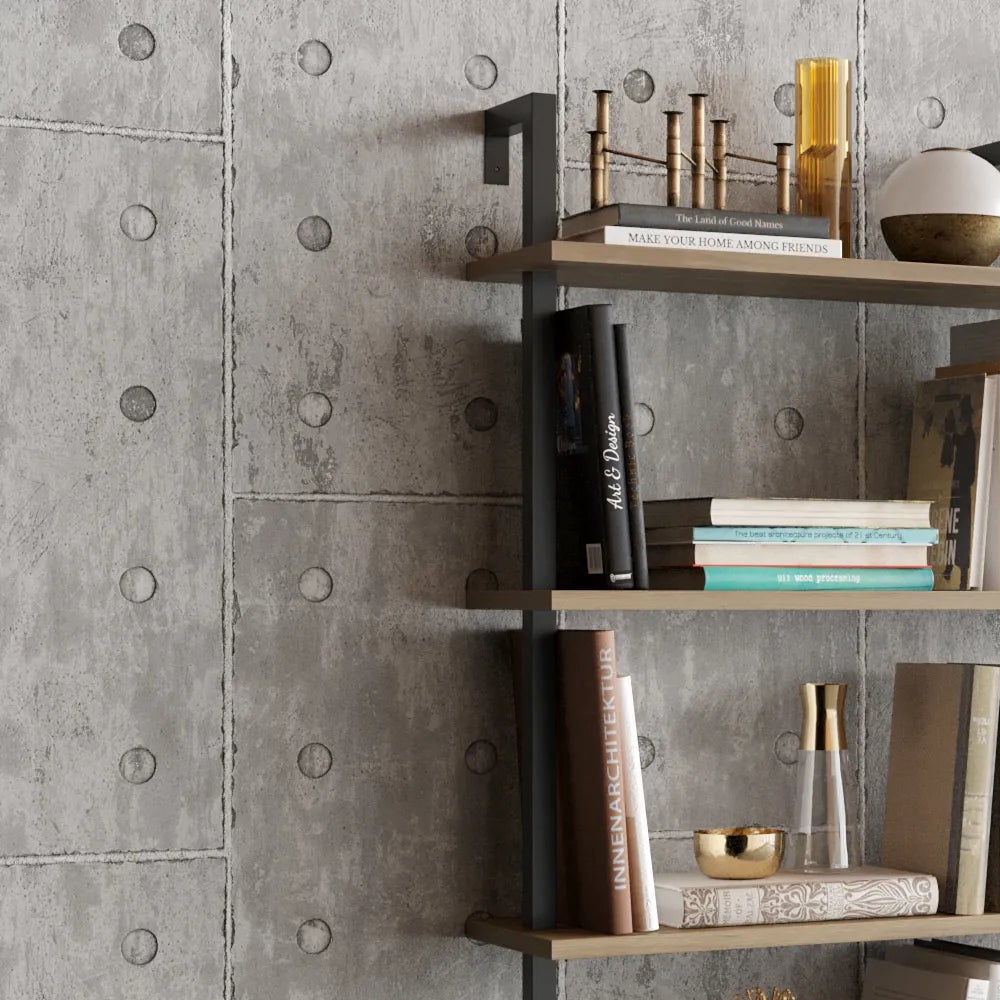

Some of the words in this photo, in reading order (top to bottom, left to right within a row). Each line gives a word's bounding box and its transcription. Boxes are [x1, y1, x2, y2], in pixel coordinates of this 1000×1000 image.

[675, 213, 693, 223] The
[695, 214, 717, 225] Land
[718, 216, 729, 226] of
[729, 217, 753, 228] Good
[755, 219, 784, 230] Names
[628, 232, 660, 245] MAKE
[663, 234, 696, 246] YOUR
[698, 236, 734, 249] HOME
[736, 238, 779, 251] AMONG
[781, 241, 829, 254] FRIENDS
[602, 412, 621, 462] Design
[604, 466, 621, 480] &
[606, 483, 624, 510] Art
[599, 647, 628, 891] INNENARCHITEKTUR
